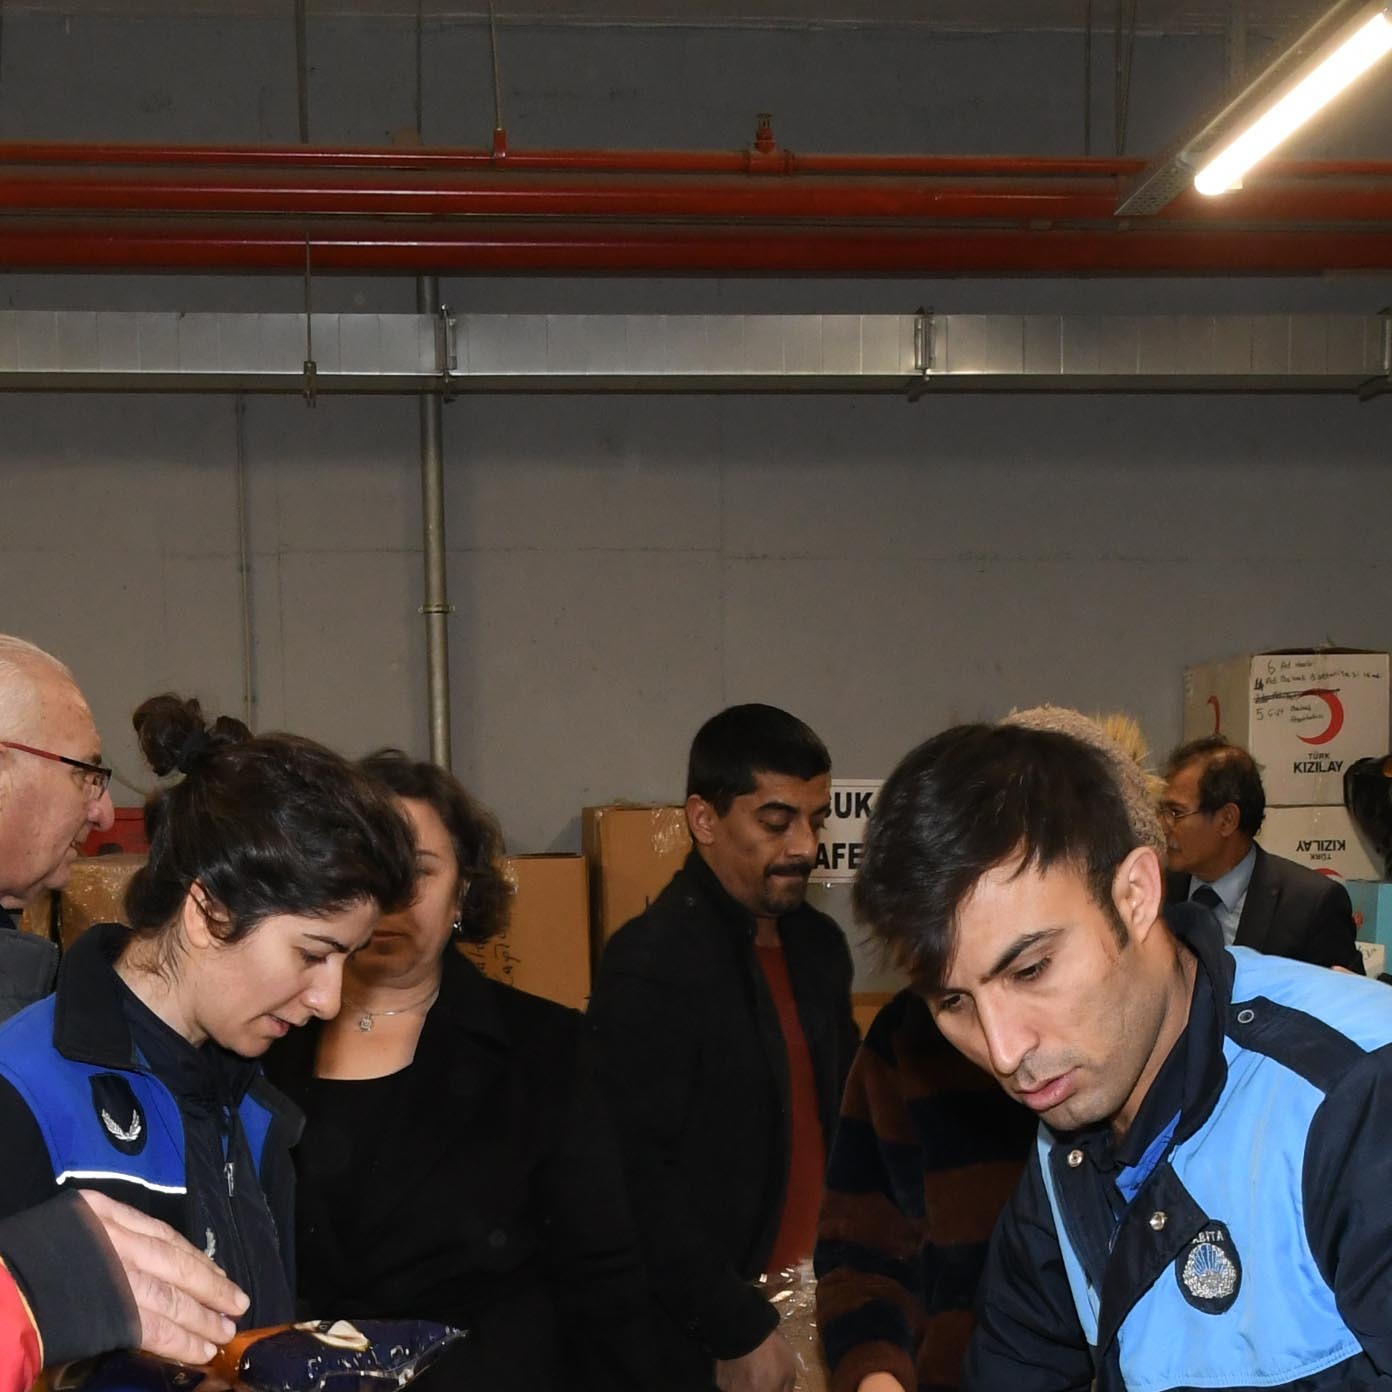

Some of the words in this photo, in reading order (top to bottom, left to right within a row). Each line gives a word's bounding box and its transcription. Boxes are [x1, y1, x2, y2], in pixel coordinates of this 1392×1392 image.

[1308, 752, 1330, 760] TÜRK
[1293, 761, 1343, 773] KIZILAY
[1296, 839, 1346, 852] KIZILAY
